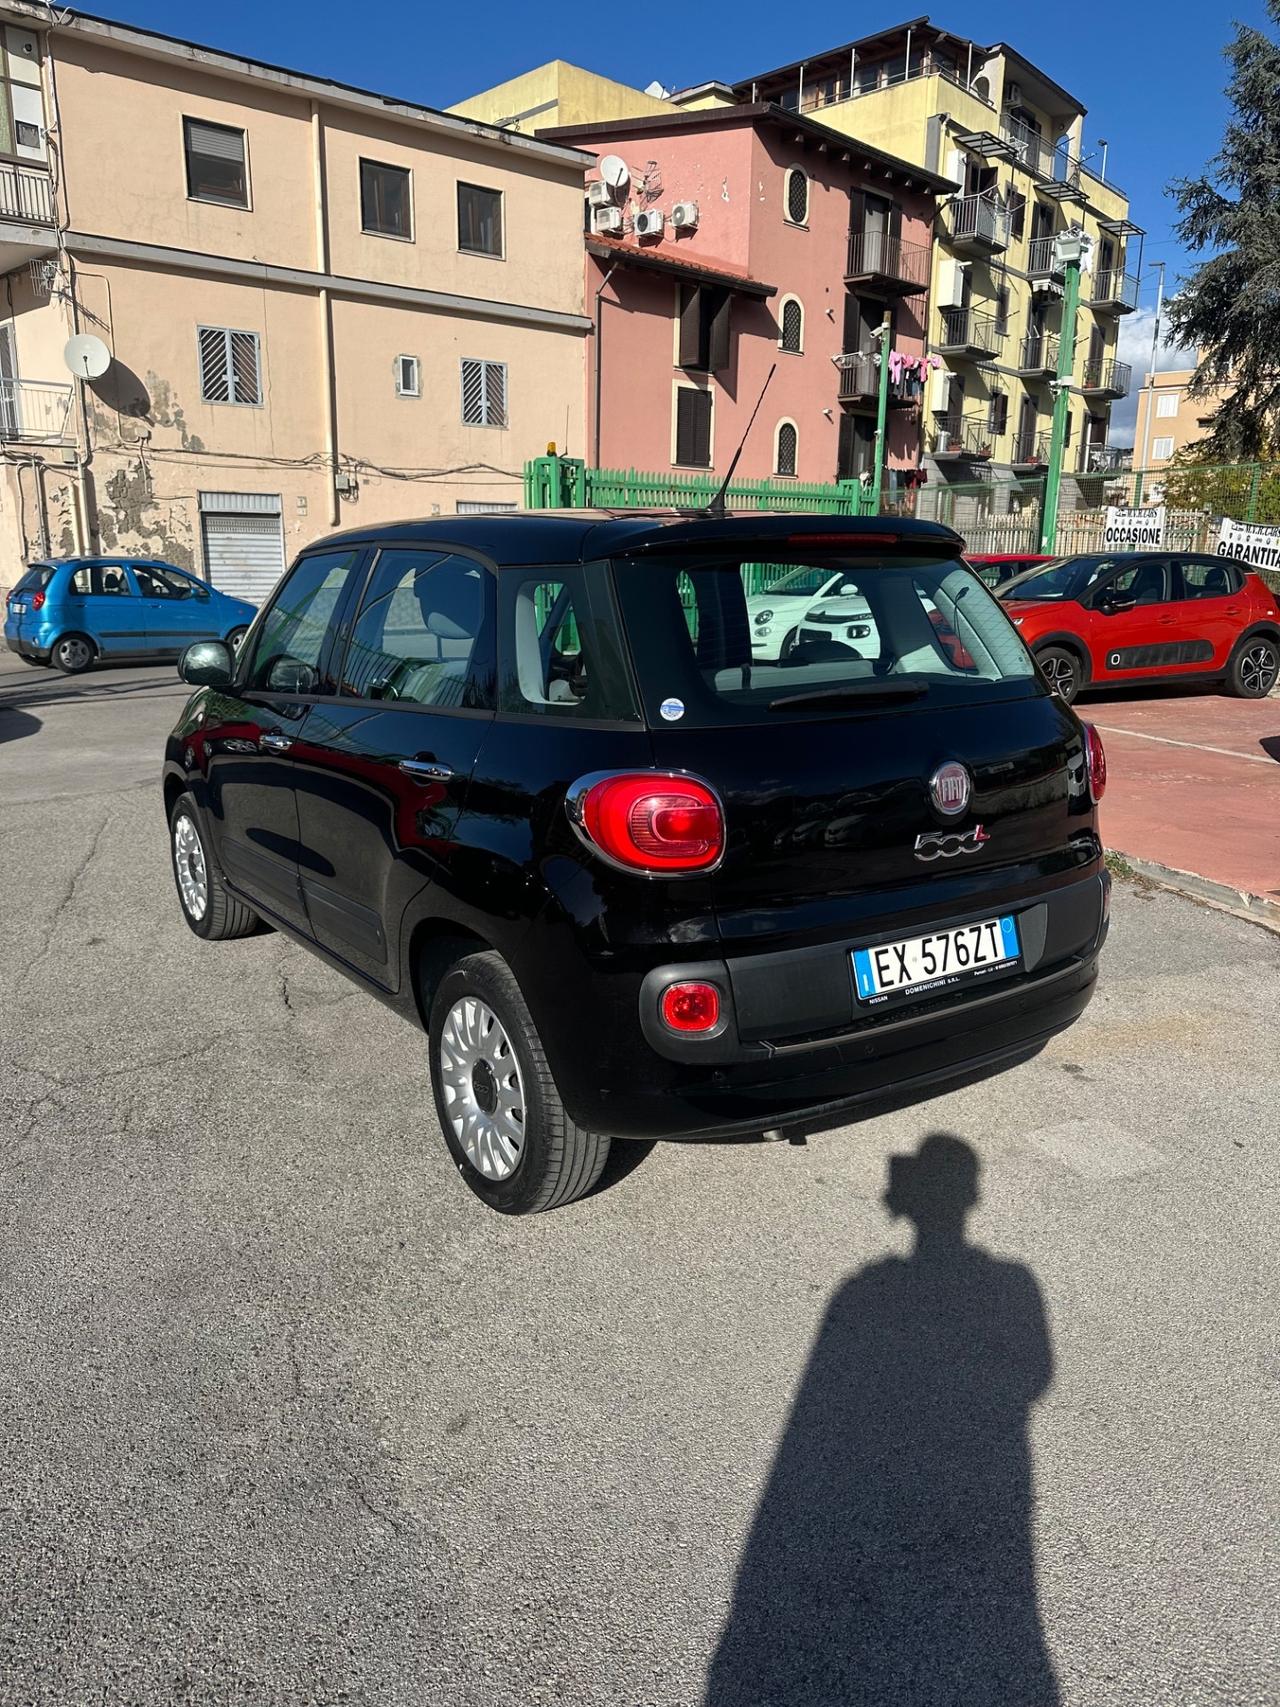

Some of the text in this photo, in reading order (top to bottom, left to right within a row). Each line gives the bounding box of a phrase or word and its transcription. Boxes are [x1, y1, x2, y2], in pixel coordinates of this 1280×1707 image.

[1106, 527, 1161, 544] OCCASIONE
[941, 776, 963, 802] FIAT
[874, 944, 912, 988] EX
[921, 922, 999, 975] 576ZT
[869, 995, 888, 1005] NISSAN
[905, 979, 946, 995] DOMENICHINI
